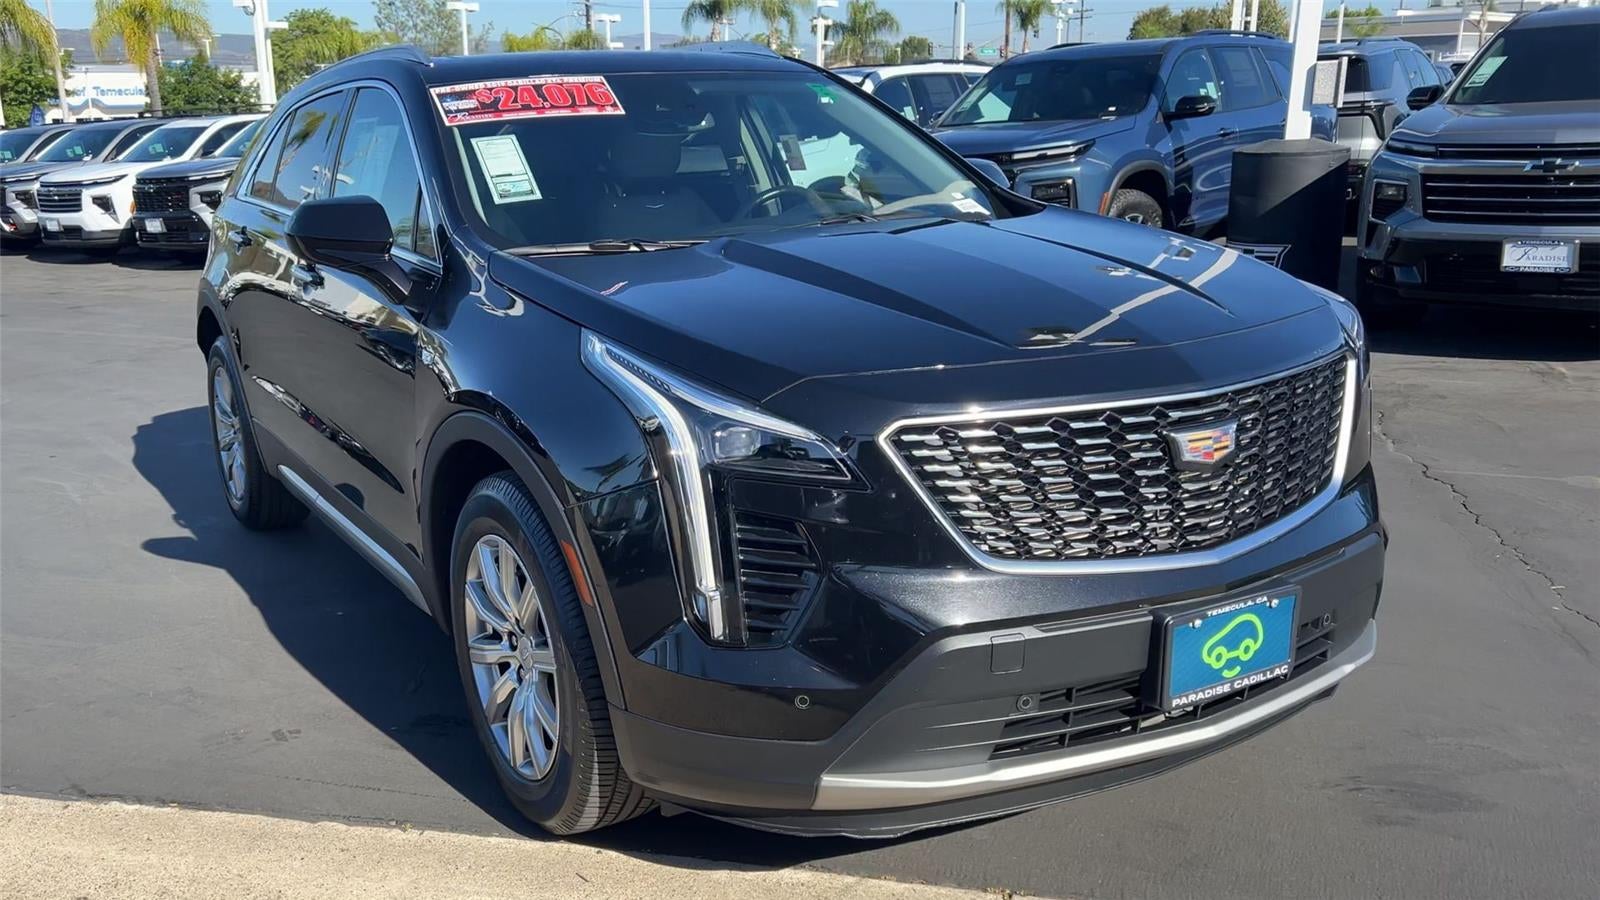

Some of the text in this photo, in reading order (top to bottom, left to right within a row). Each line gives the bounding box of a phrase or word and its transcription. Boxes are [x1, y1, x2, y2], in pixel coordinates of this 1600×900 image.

[475, 83, 614, 110] $24,076
[1255, 596, 1269, 605] CA
[1172, 665, 1289, 707] PARADISE CADILLAC
